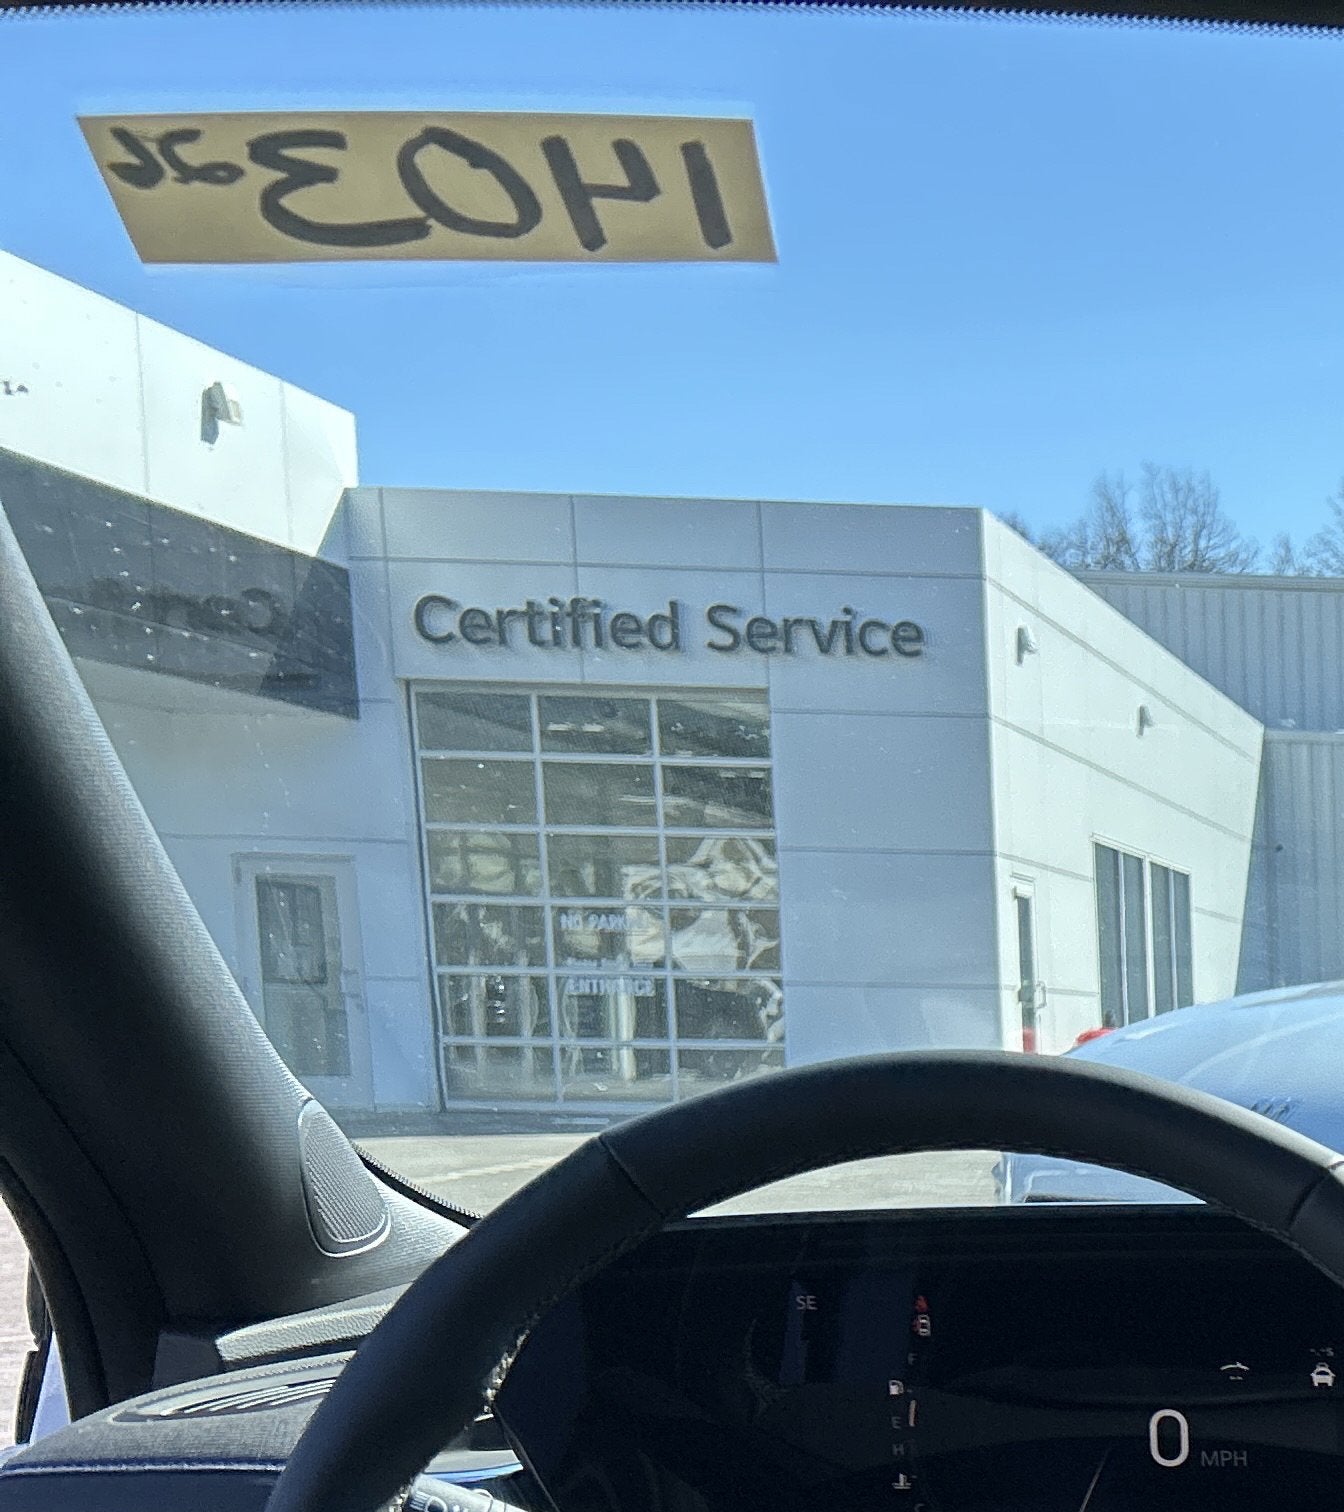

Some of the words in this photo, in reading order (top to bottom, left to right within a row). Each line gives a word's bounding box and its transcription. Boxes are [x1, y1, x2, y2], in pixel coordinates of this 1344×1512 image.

[414, 594, 681, 653] Certified
[706, 604, 925, 658] Service
[796, 1295, 818, 1310] SE
[1149, 1408, 1190, 1467] 0
[1201, 1450, 1248, 1467] MPH
